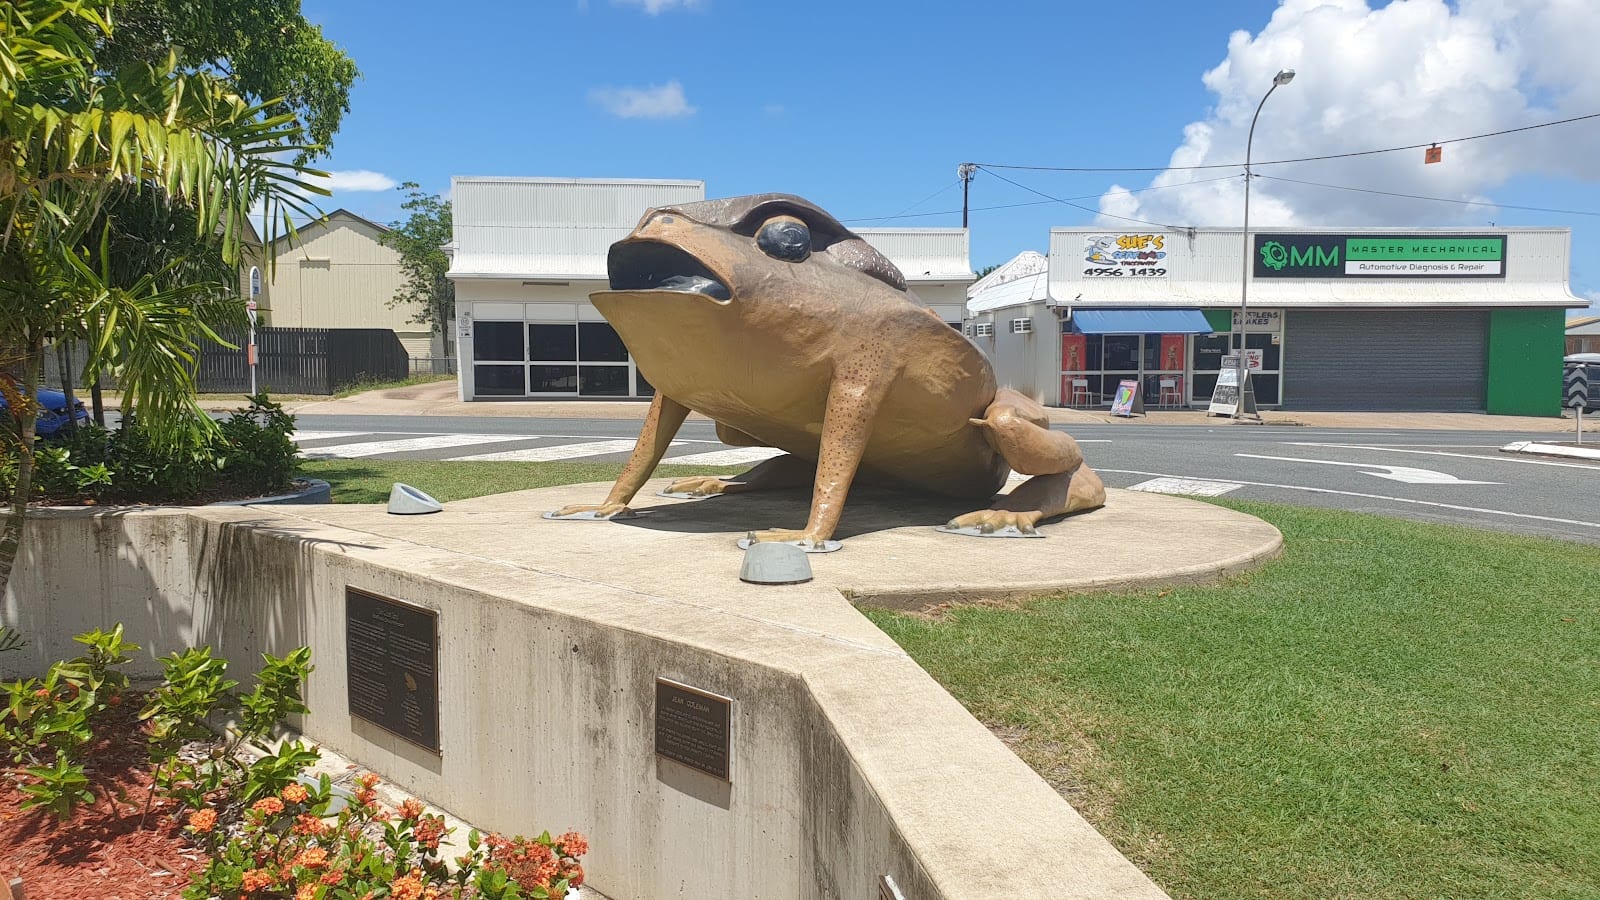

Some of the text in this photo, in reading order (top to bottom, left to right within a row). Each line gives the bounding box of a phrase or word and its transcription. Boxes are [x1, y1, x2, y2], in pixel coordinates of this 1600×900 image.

[1116, 234, 1165, 250] SUE'S
[1290, 245, 1339, 267] MM
[1359, 263, 1407, 271] Automotive
[1409, 263, 1449, 272] Diagnosis
[1458, 263, 1485, 271] Repair
[1083, 268, 1167, 277] 4956 1439
[672, 696, 684, 704] JEAN
